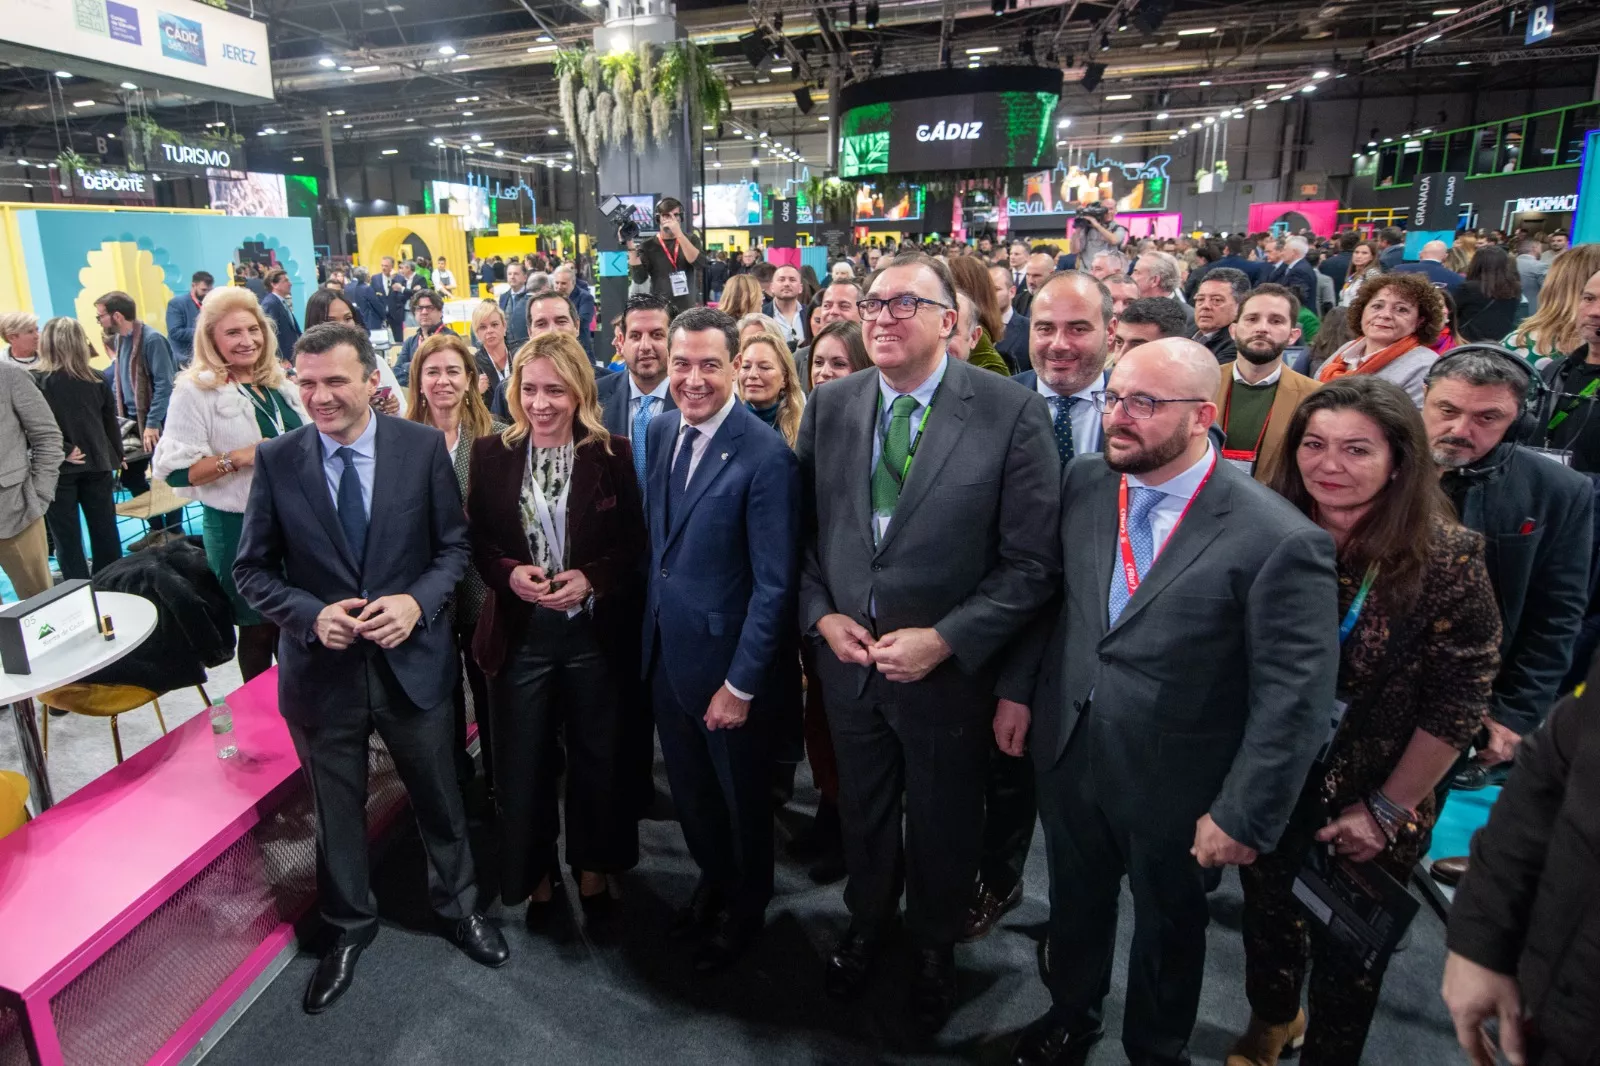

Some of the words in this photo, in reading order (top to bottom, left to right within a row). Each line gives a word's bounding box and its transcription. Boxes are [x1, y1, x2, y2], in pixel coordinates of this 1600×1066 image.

[1532, 5, 1548, 36] B
[222, 43, 257, 65] JEREZ
[916, 120, 983, 142] CÁDIZ
[96, 137, 108, 154] B
[161, 144, 230, 167] TURISMO
[83, 176, 145, 192] DEPORTE
[1445, 176, 1456, 206] CIUDAD
[781, 202, 790, 222] CÁDIZ
[1009, 201, 1064, 214] SEVILA
[1415, 176, 1431, 226] GRANADA
[24, 615, 36, 628] 05
